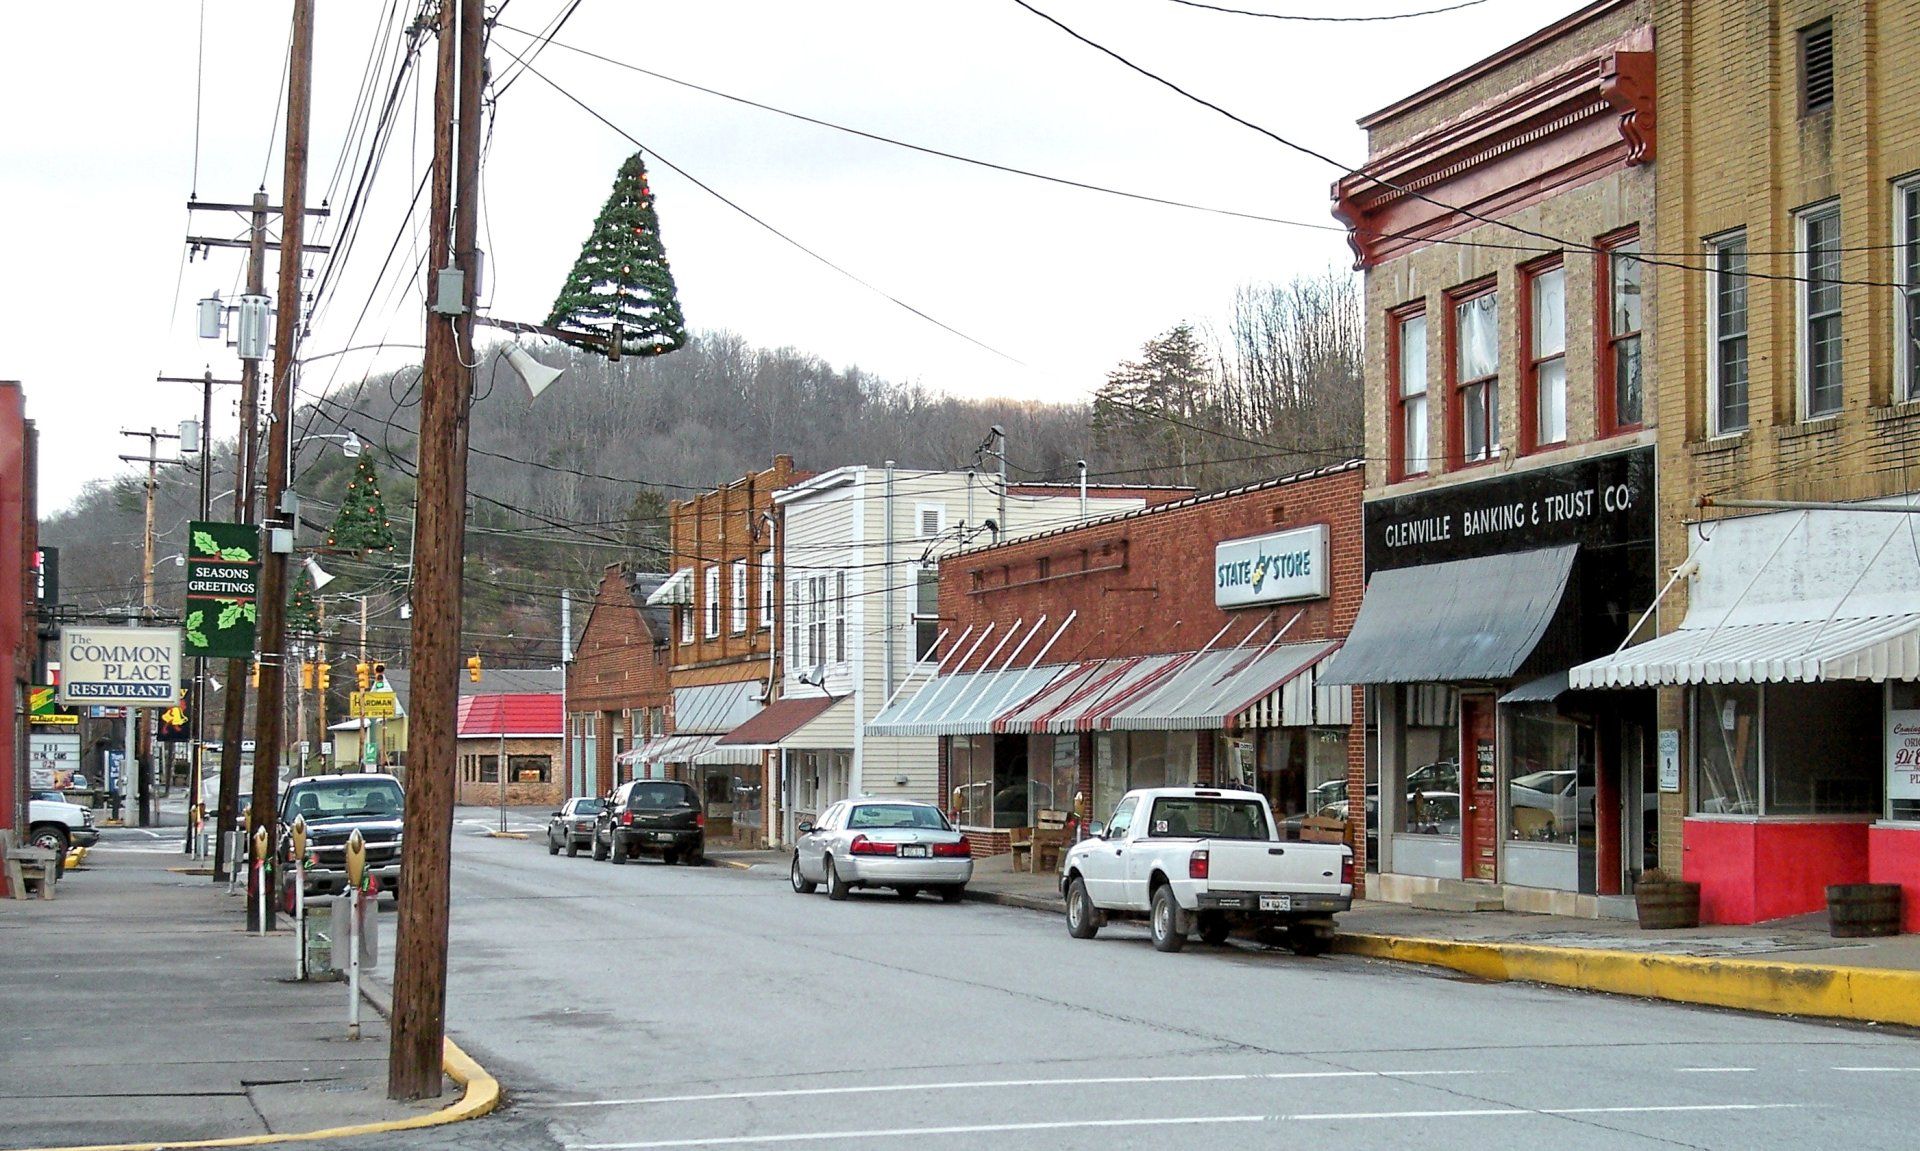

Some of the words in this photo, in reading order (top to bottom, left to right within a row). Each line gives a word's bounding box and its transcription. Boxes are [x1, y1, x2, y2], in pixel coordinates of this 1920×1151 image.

[1385, 515, 1451, 548] GLENVILLE
[1464, 503, 1525, 537] BANKING
[1531, 502, 1540, 526] &
[1544, 489, 1595, 523] TRUST
[1604, 483, 1632, 513] CO.
[195, 567, 249, 579] SEASONS
[1218, 559, 1251, 588] STATE
[1272, 549, 1311, 580] STORE
[188, 580, 255, 594] GREETINGS
[69, 634, 92, 645] The
[70, 645, 172, 663] COMMON
[103, 663, 172, 681] PLACE
[70, 684, 170, 697] RESTAURANT
[354, 694, 392, 707] HRDMAN
